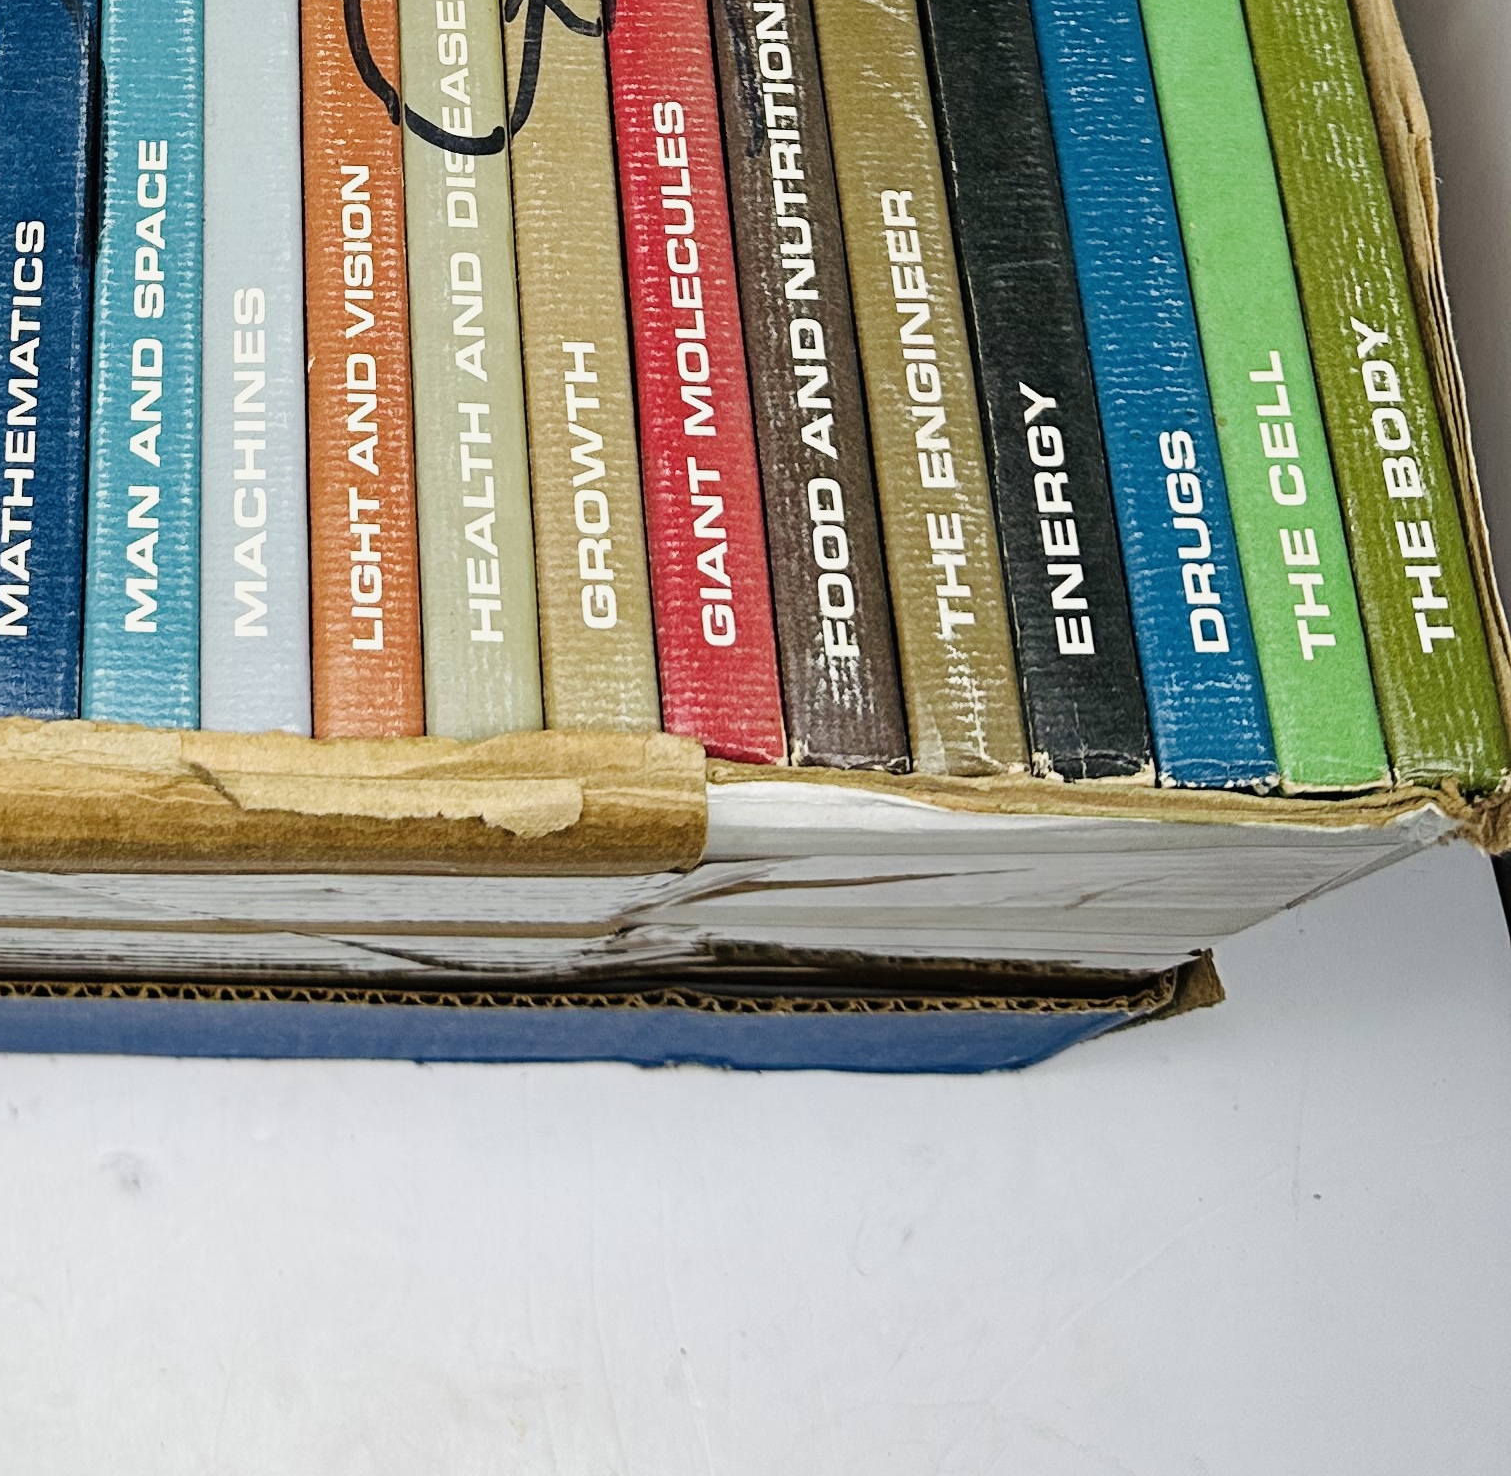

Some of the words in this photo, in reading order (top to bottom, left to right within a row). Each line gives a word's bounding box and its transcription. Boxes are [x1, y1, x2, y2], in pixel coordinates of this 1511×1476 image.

[135, 139, 168, 318] SPACE
[756, 2, 820, 299] NUTRITION
[341, 165, 373, 338] VISION
[447, 252, 489, 382] AND
[655, 102, 717, 437] MOLECULES
[882, 190, 955, 488] ENGINEER
[130, 338, 163, 466] AND
[234, 287, 267, 637] MACHINES
[348, 353, 379, 474] AND
[790, 319, 839, 459] AND
[1251, 351, 1307, 504] CELL
[1350, 317, 1424, 500] BODY
[125, 486, 160, 632] MAN
[349, 488, 383, 650] LIGHT
[455, 401, 504, 642] HEALTH
[564, 341, 617, 629] GROWTH
[689, 457, 736, 646] GIANT
[809, 477, 859, 659] FOOD
[1020, 382, 1094, 654] ENERGY
[1161, 431, 1228, 653] DRUGS
[925, 513, 974, 637] THE
[1279, 528, 1336, 659] THE
[1393, 521, 1456, 654] THE
